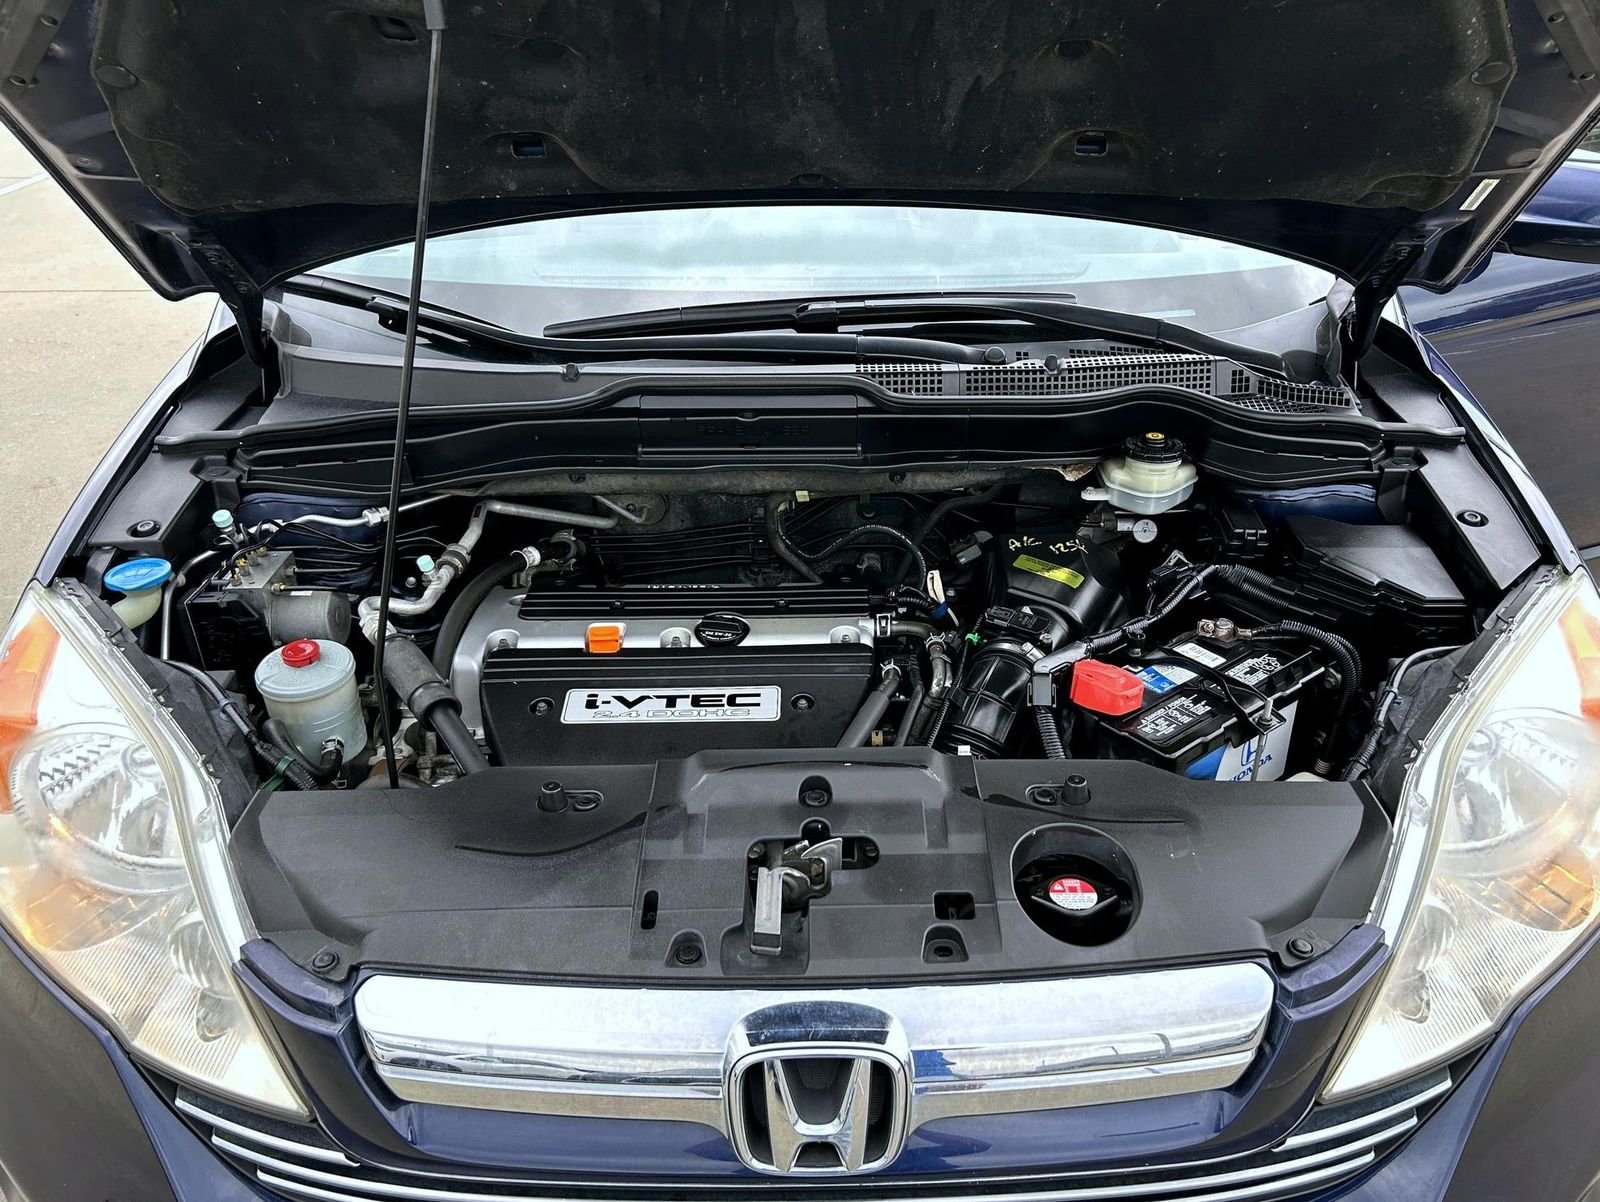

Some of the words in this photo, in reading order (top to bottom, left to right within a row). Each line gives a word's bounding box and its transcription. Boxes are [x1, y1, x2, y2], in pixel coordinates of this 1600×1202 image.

[584, 692, 762, 710] i-VTEC
[592, 711, 641, 720] 2.4
[646, 709, 751, 719] DOHC
